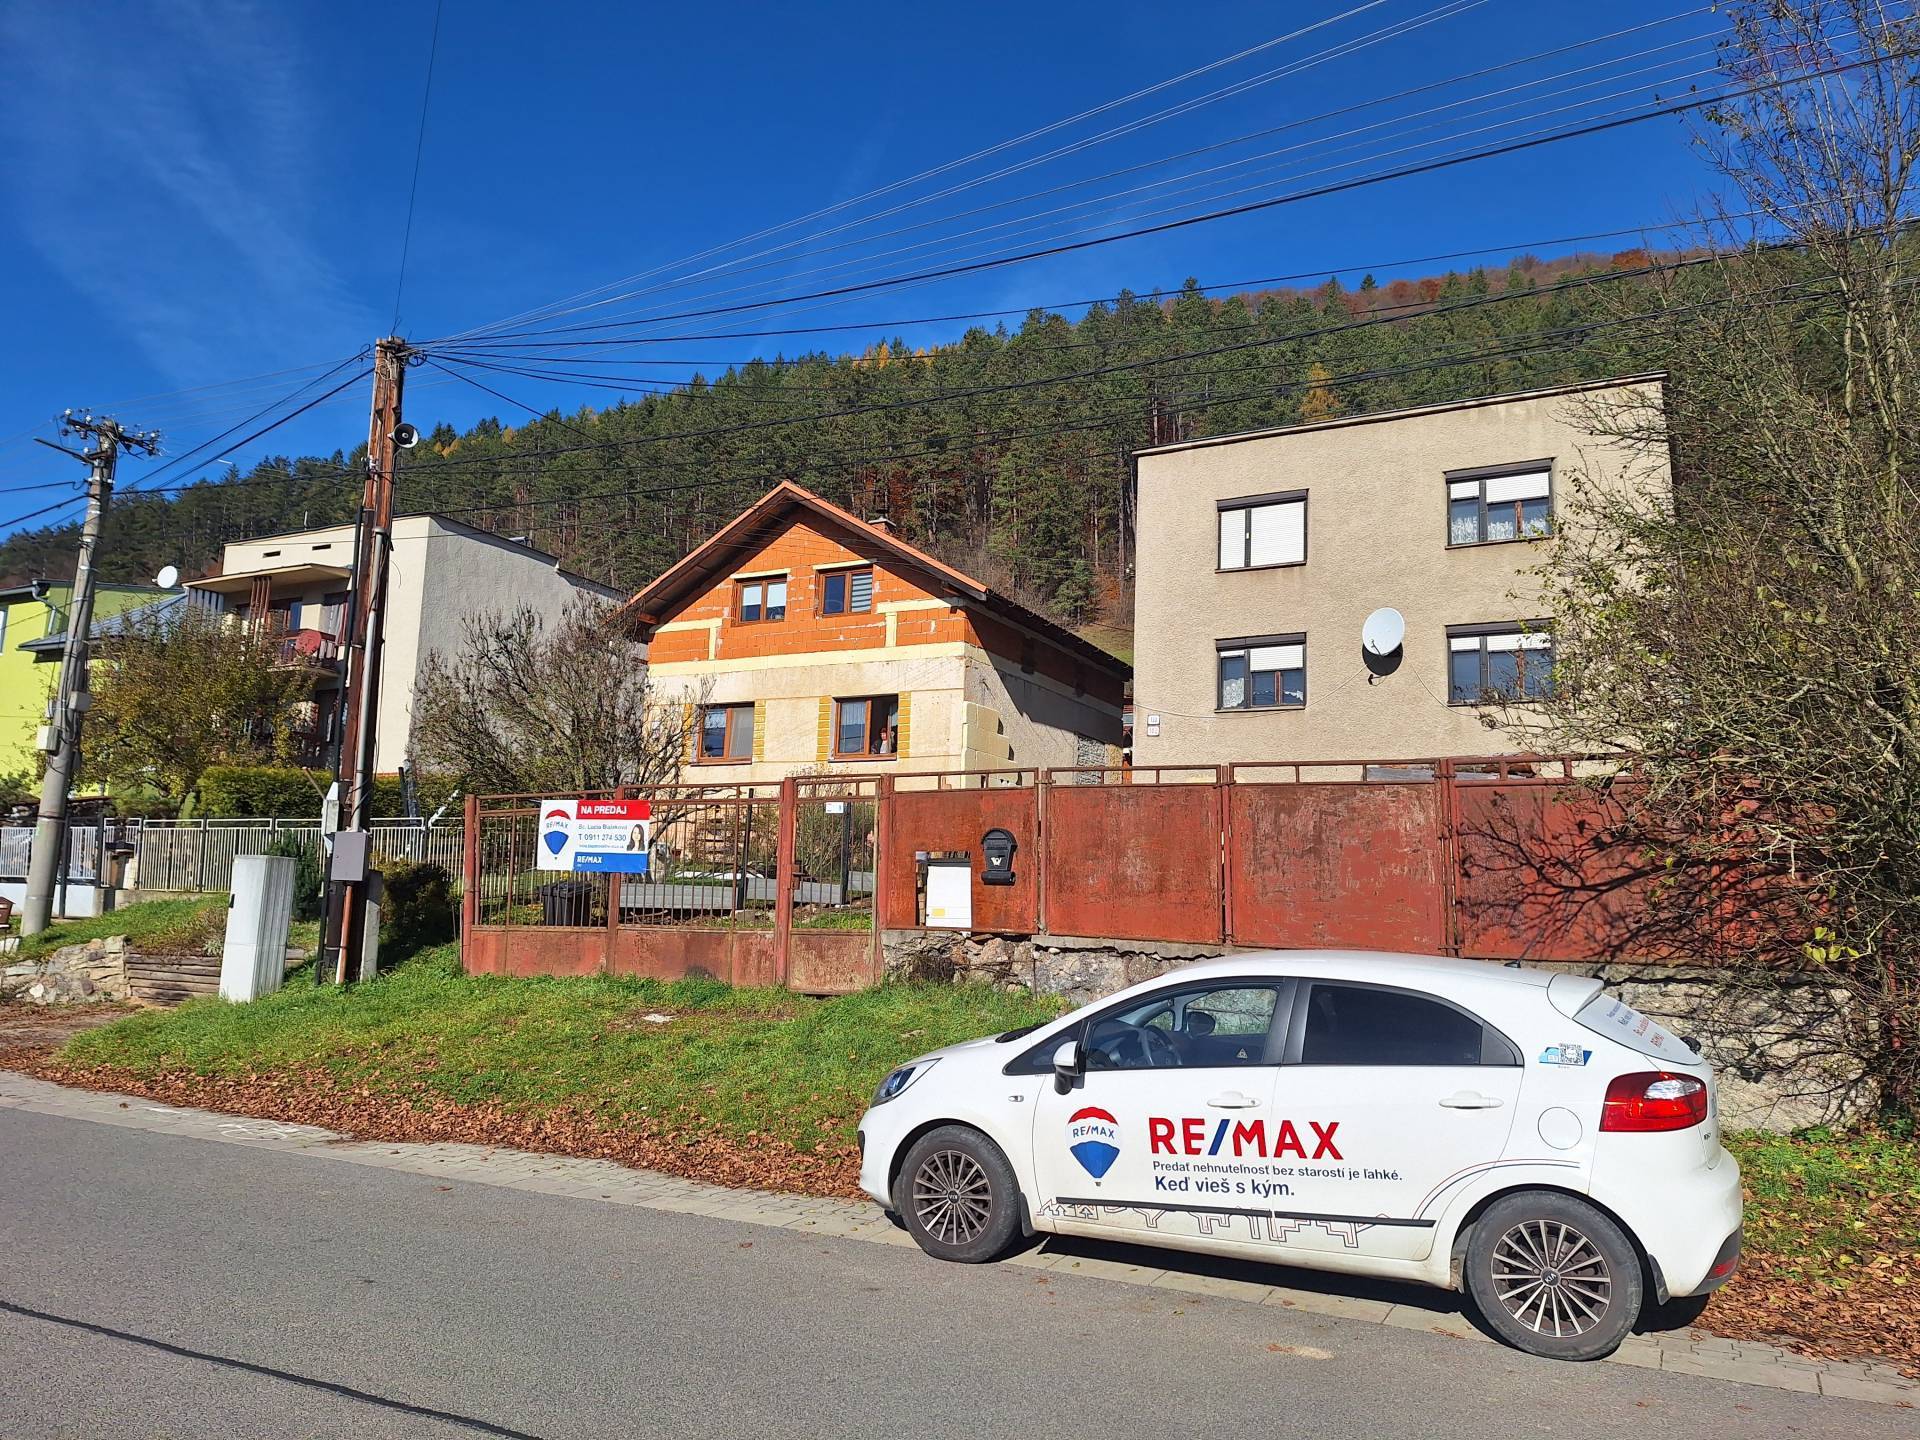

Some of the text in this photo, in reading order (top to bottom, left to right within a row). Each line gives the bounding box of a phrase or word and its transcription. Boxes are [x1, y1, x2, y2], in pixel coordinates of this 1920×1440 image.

[581, 805, 627, 815] NA PREDAJ
[546, 821, 568, 829] RE/MAX
[578, 833, 582, 841] T
[584, 833, 600, 841] 0911
[614, 833, 627, 842] 530
[576, 855, 602, 864] RE/MAX
[1072, 1125, 1115, 1140] RE/MAX
[1148, 1117, 1344, 1160] RE/MAX
[1153, 1161, 1403, 1181] Predať nehnuteľnosť bez starostí je ľahké.
[1155, 1175, 1295, 1198] Keď vieš s kým.
[1545, 1273, 1557, 1283] KIA
